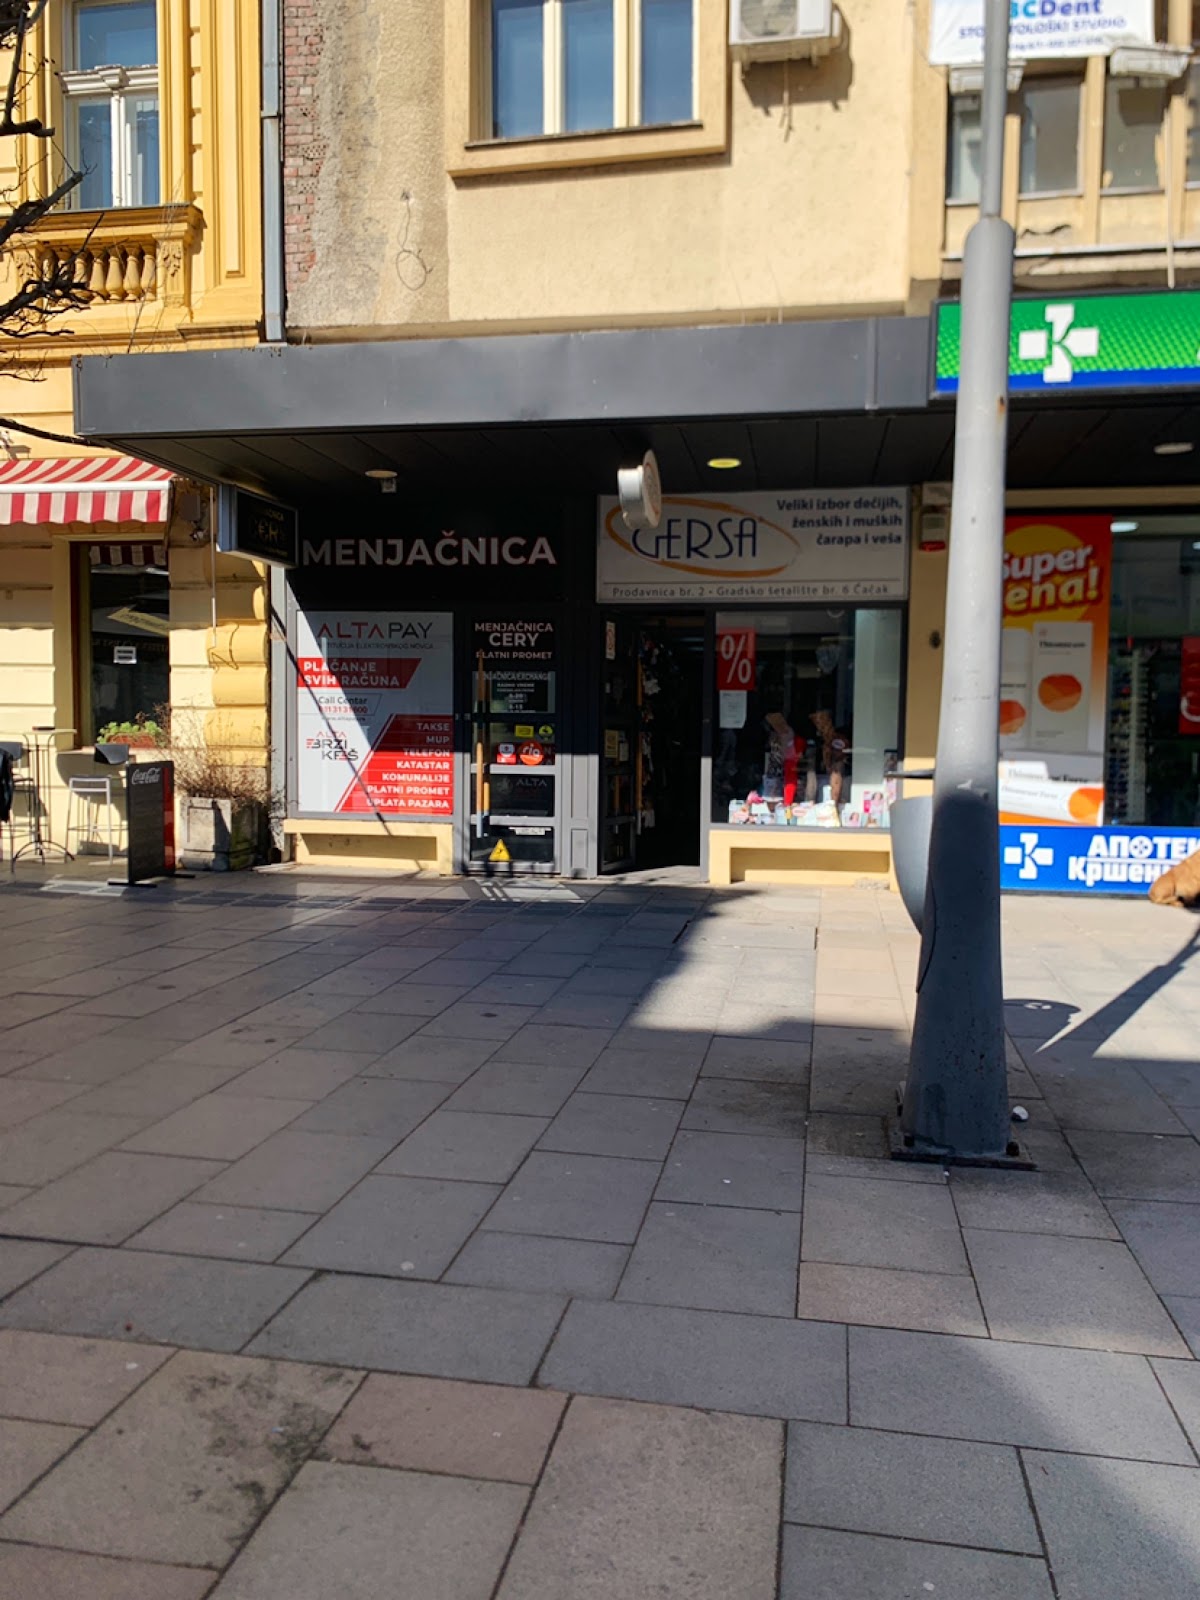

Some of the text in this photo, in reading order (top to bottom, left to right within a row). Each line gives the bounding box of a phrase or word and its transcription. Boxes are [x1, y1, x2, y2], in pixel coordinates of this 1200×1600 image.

[777, 500, 813, 511] Veliki
[816, 498, 851, 510] izbor
[792, 514, 902, 528] ženskih i muških
[632, 517, 757, 560] GERSA
[816, 533, 901, 546] čarapa i veša
[302, 530, 557, 566] MENJAČNICA
[612, 586, 676, 597] Prodavnica
[679, 586, 695, 597] br.
[698, 587, 705, 597] 2
[716, 586, 765, 596] Gradsko
[768, 584, 818, 596] šetalište
[822, 585, 837, 596] br.
[842, 585, 849, 595] 6
[1005, 565, 1100, 612] ena!
[474, 620, 554, 632] MENJAČNICA
[488, 632, 539, 647] CERY
[475, 650, 553, 660] PLATNI PROMET
[304, 671, 400, 686] SVIH RAČUNA
[318, 696, 335, 705] Call
[416, 722, 450, 731] TAKSE
[426, 735, 450, 744] MUP
[402, 747, 450, 757] TELEFON
[396, 760, 450, 770] KATASTAR
[382, 773, 450, 783] KOMUNALIJE
[366, 785, 450, 795] PLATNI PROMET
[408, 799, 450, 808] PAZARA
[1068, 856, 1171, 887] Кршен
